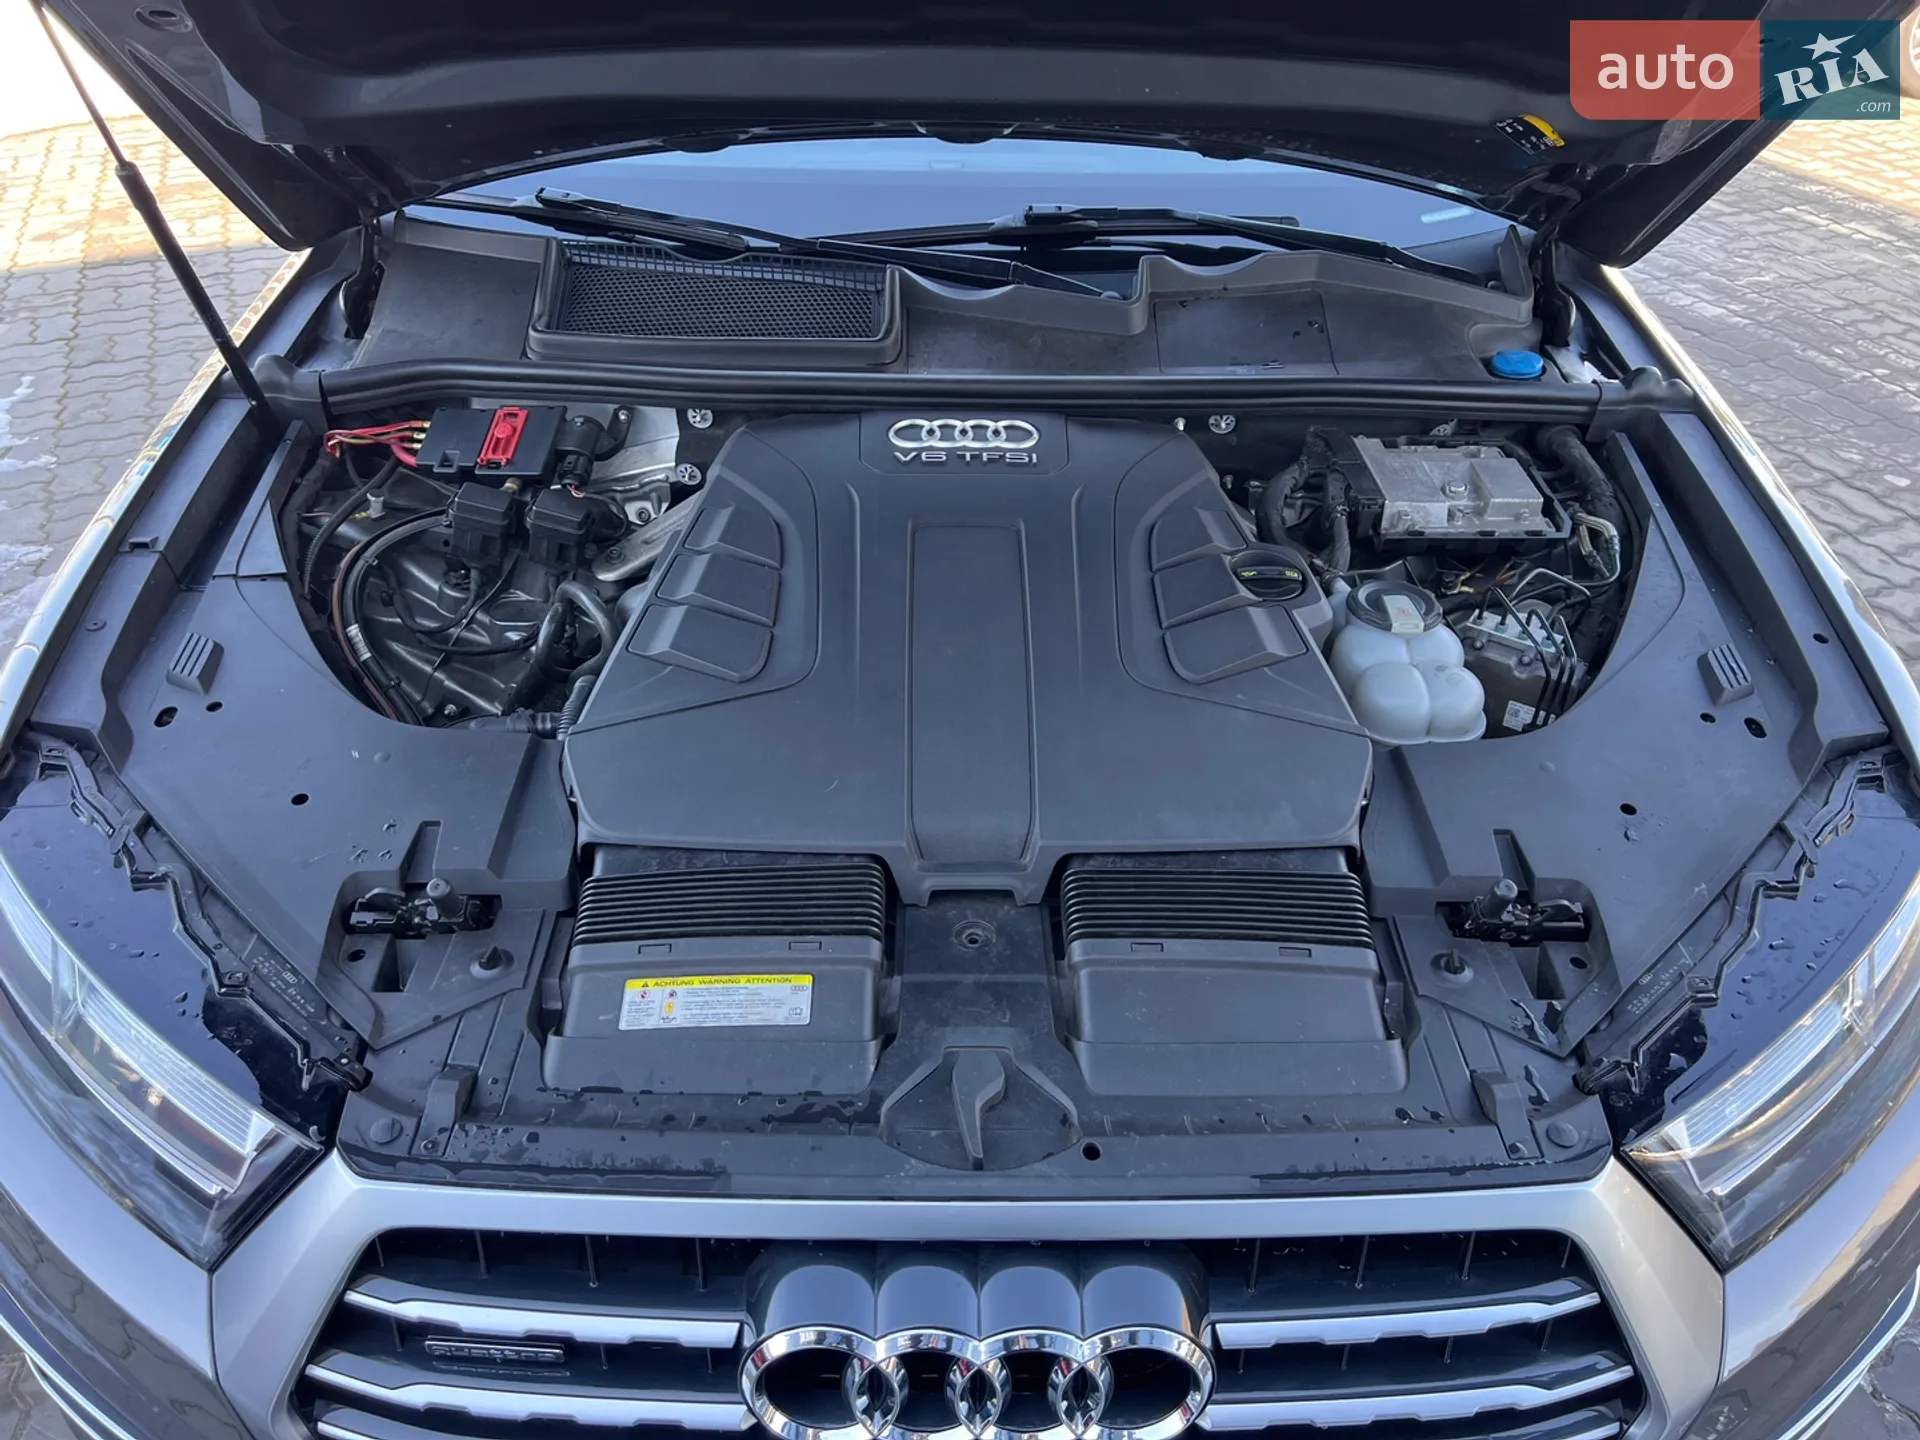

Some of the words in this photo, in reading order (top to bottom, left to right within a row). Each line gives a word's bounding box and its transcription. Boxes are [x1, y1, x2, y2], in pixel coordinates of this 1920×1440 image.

[893, 451, 947, 463] V6
[956, 451, 1038, 464] TFSI
[653, 979, 695, 988] ACHTUNG
[698, 977, 741, 985] WARNING
